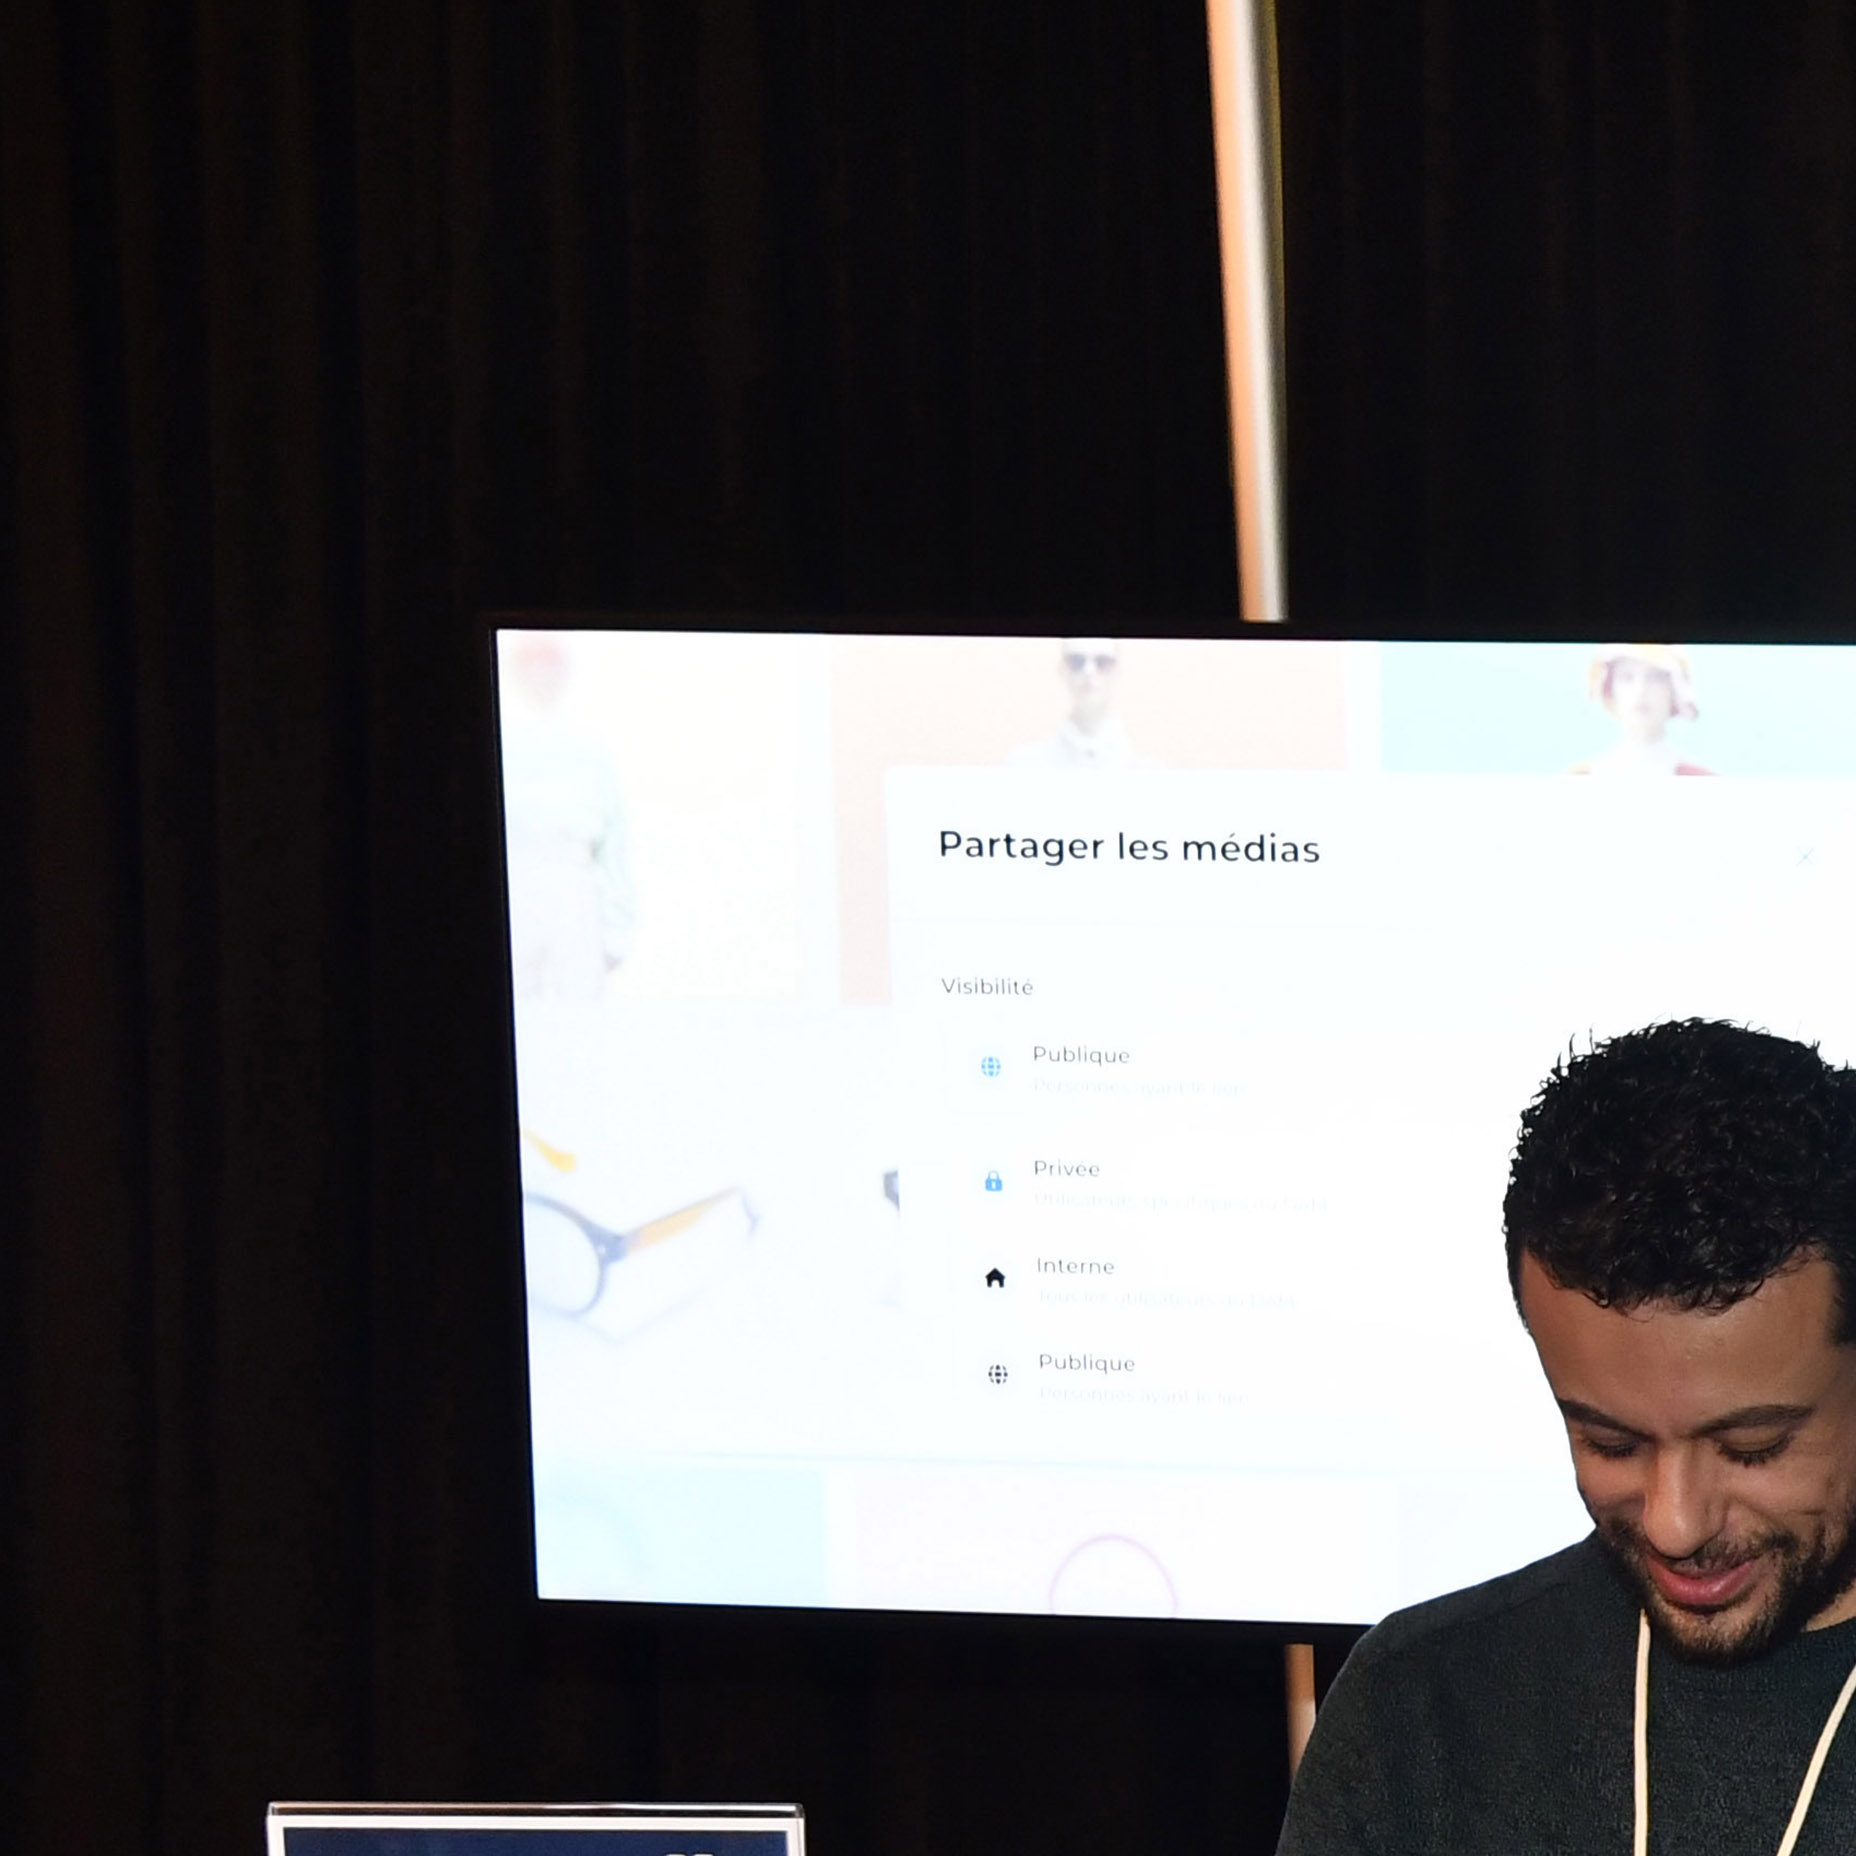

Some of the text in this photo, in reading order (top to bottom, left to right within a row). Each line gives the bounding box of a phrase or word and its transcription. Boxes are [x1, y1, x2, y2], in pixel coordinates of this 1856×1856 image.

[940, 829, 1320, 867] Partager les médias
[941, 977, 1034, 996] Visibilité
[1033, 1044, 1130, 1067] Publique
[1034, 1158, 1100, 1178] Privée
[1037, 1256, 1115, 1275] Interne
[1039, 1352, 1136, 1375] Publique
